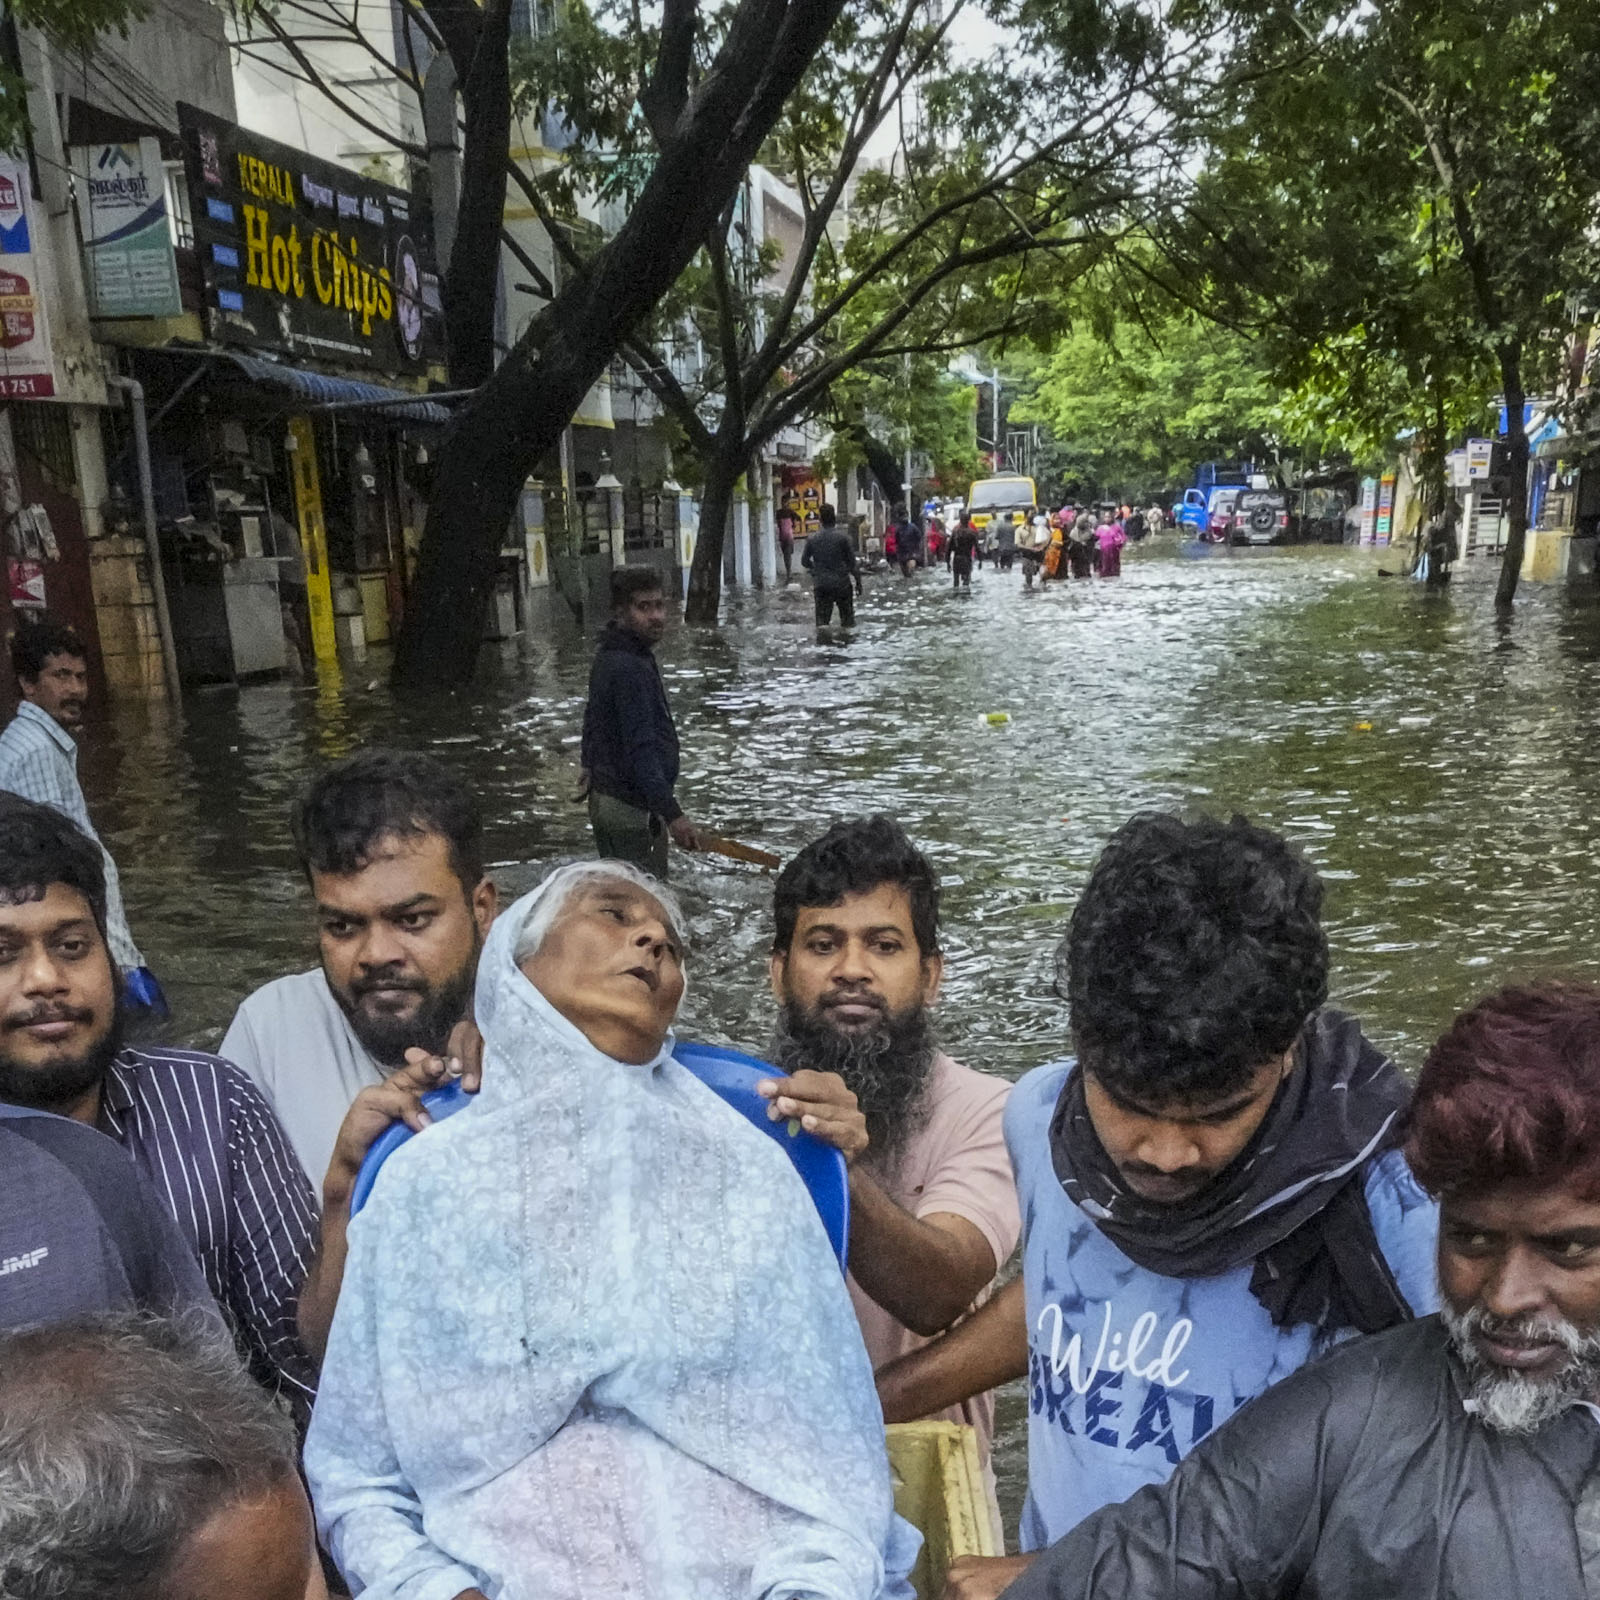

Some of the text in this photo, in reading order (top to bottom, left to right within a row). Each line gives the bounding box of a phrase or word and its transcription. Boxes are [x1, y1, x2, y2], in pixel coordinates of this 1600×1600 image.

[237, 152, 295, 209] KERALA
[242, 203, 305, 298] Hot
[311, 228, 393, 337] Chips
[11, 379, 35, 393] 751
[1038, 1301, 1192, 1394] Wild
